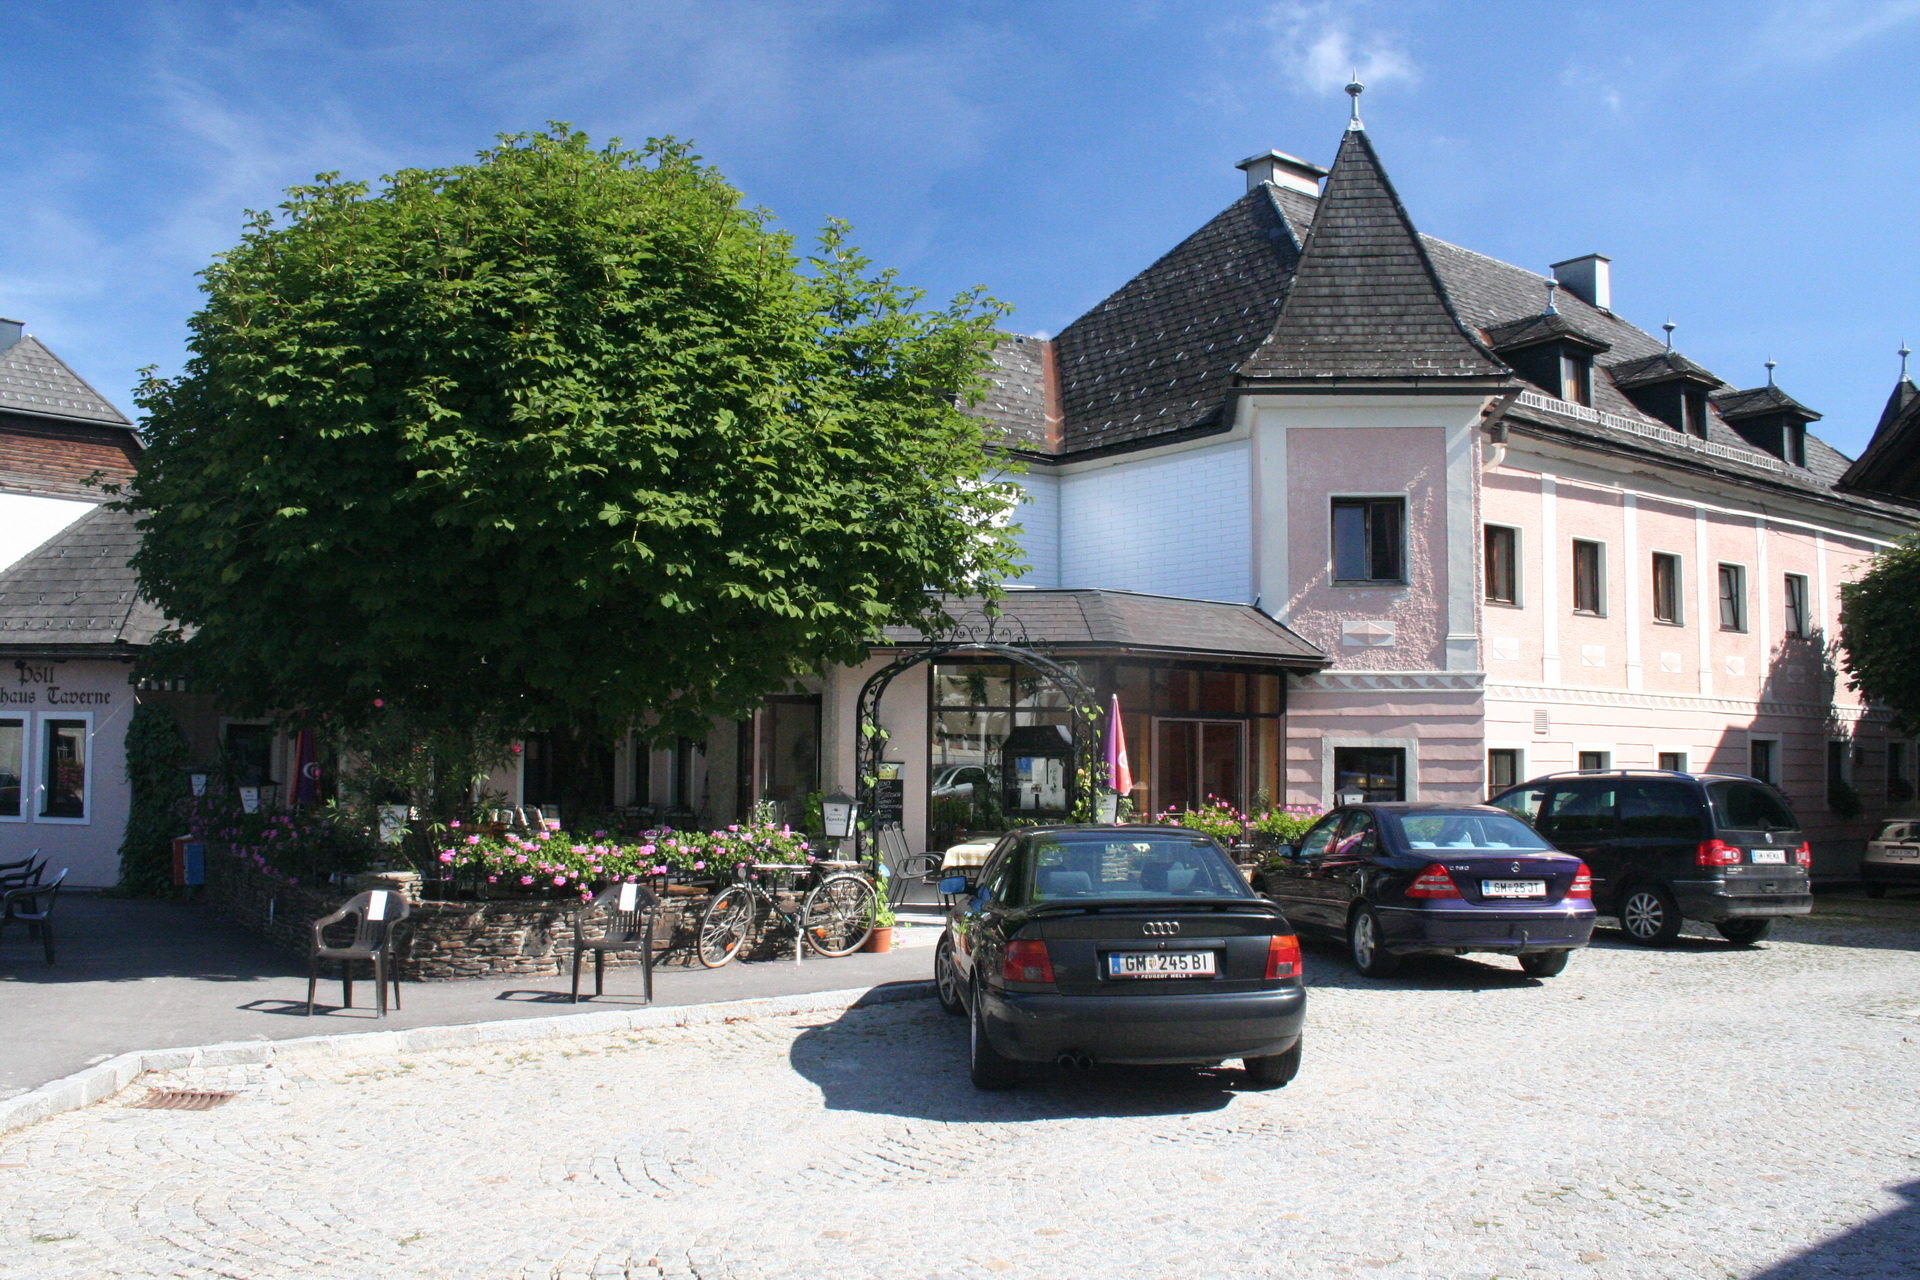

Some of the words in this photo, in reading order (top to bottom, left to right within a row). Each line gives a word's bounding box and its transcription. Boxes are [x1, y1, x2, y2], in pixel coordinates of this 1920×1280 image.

[16, 662, 55, 686] Pöll
[47, 687, 111, 705] Taverne
[1494, 882, 1507, 893] GM
[1513, 882, 1526, 893] 25
[1125, 956, 1146, 971] GM
[1159, 955, 1188, 970] 245
[1192, 954, 1207, 970] BI
